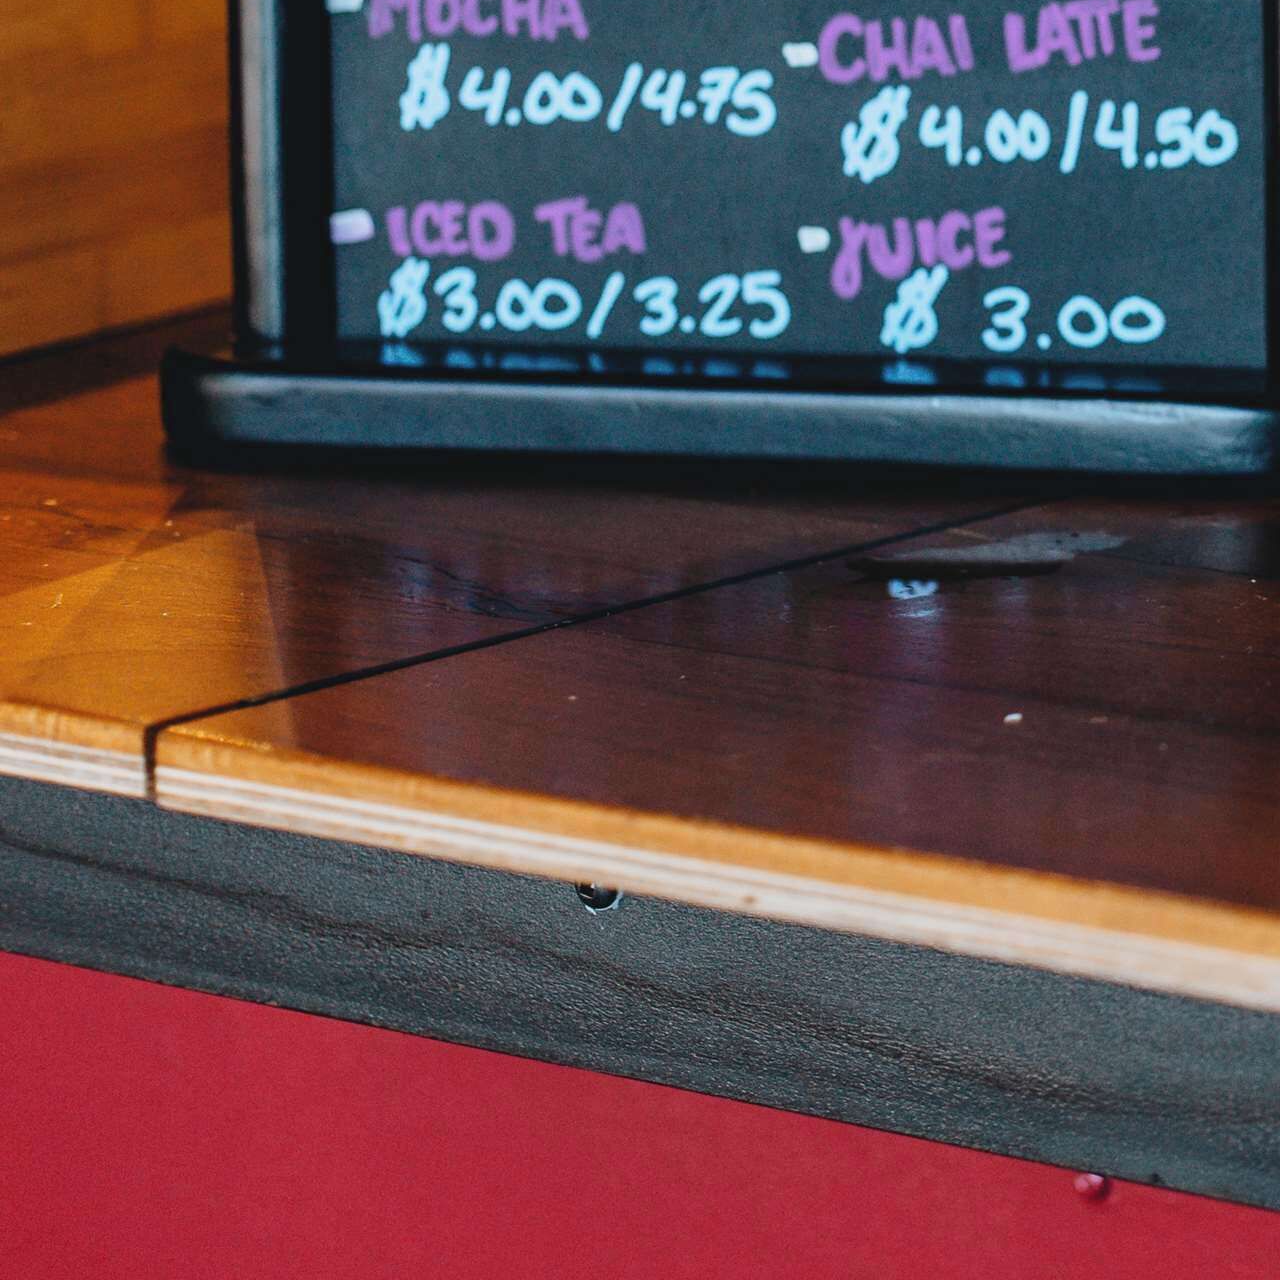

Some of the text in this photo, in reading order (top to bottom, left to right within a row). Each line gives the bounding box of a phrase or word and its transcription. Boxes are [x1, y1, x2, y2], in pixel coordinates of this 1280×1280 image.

[819, 12, 971, 82] CHAI
[387, 197, 644, 256] ICED TEA
